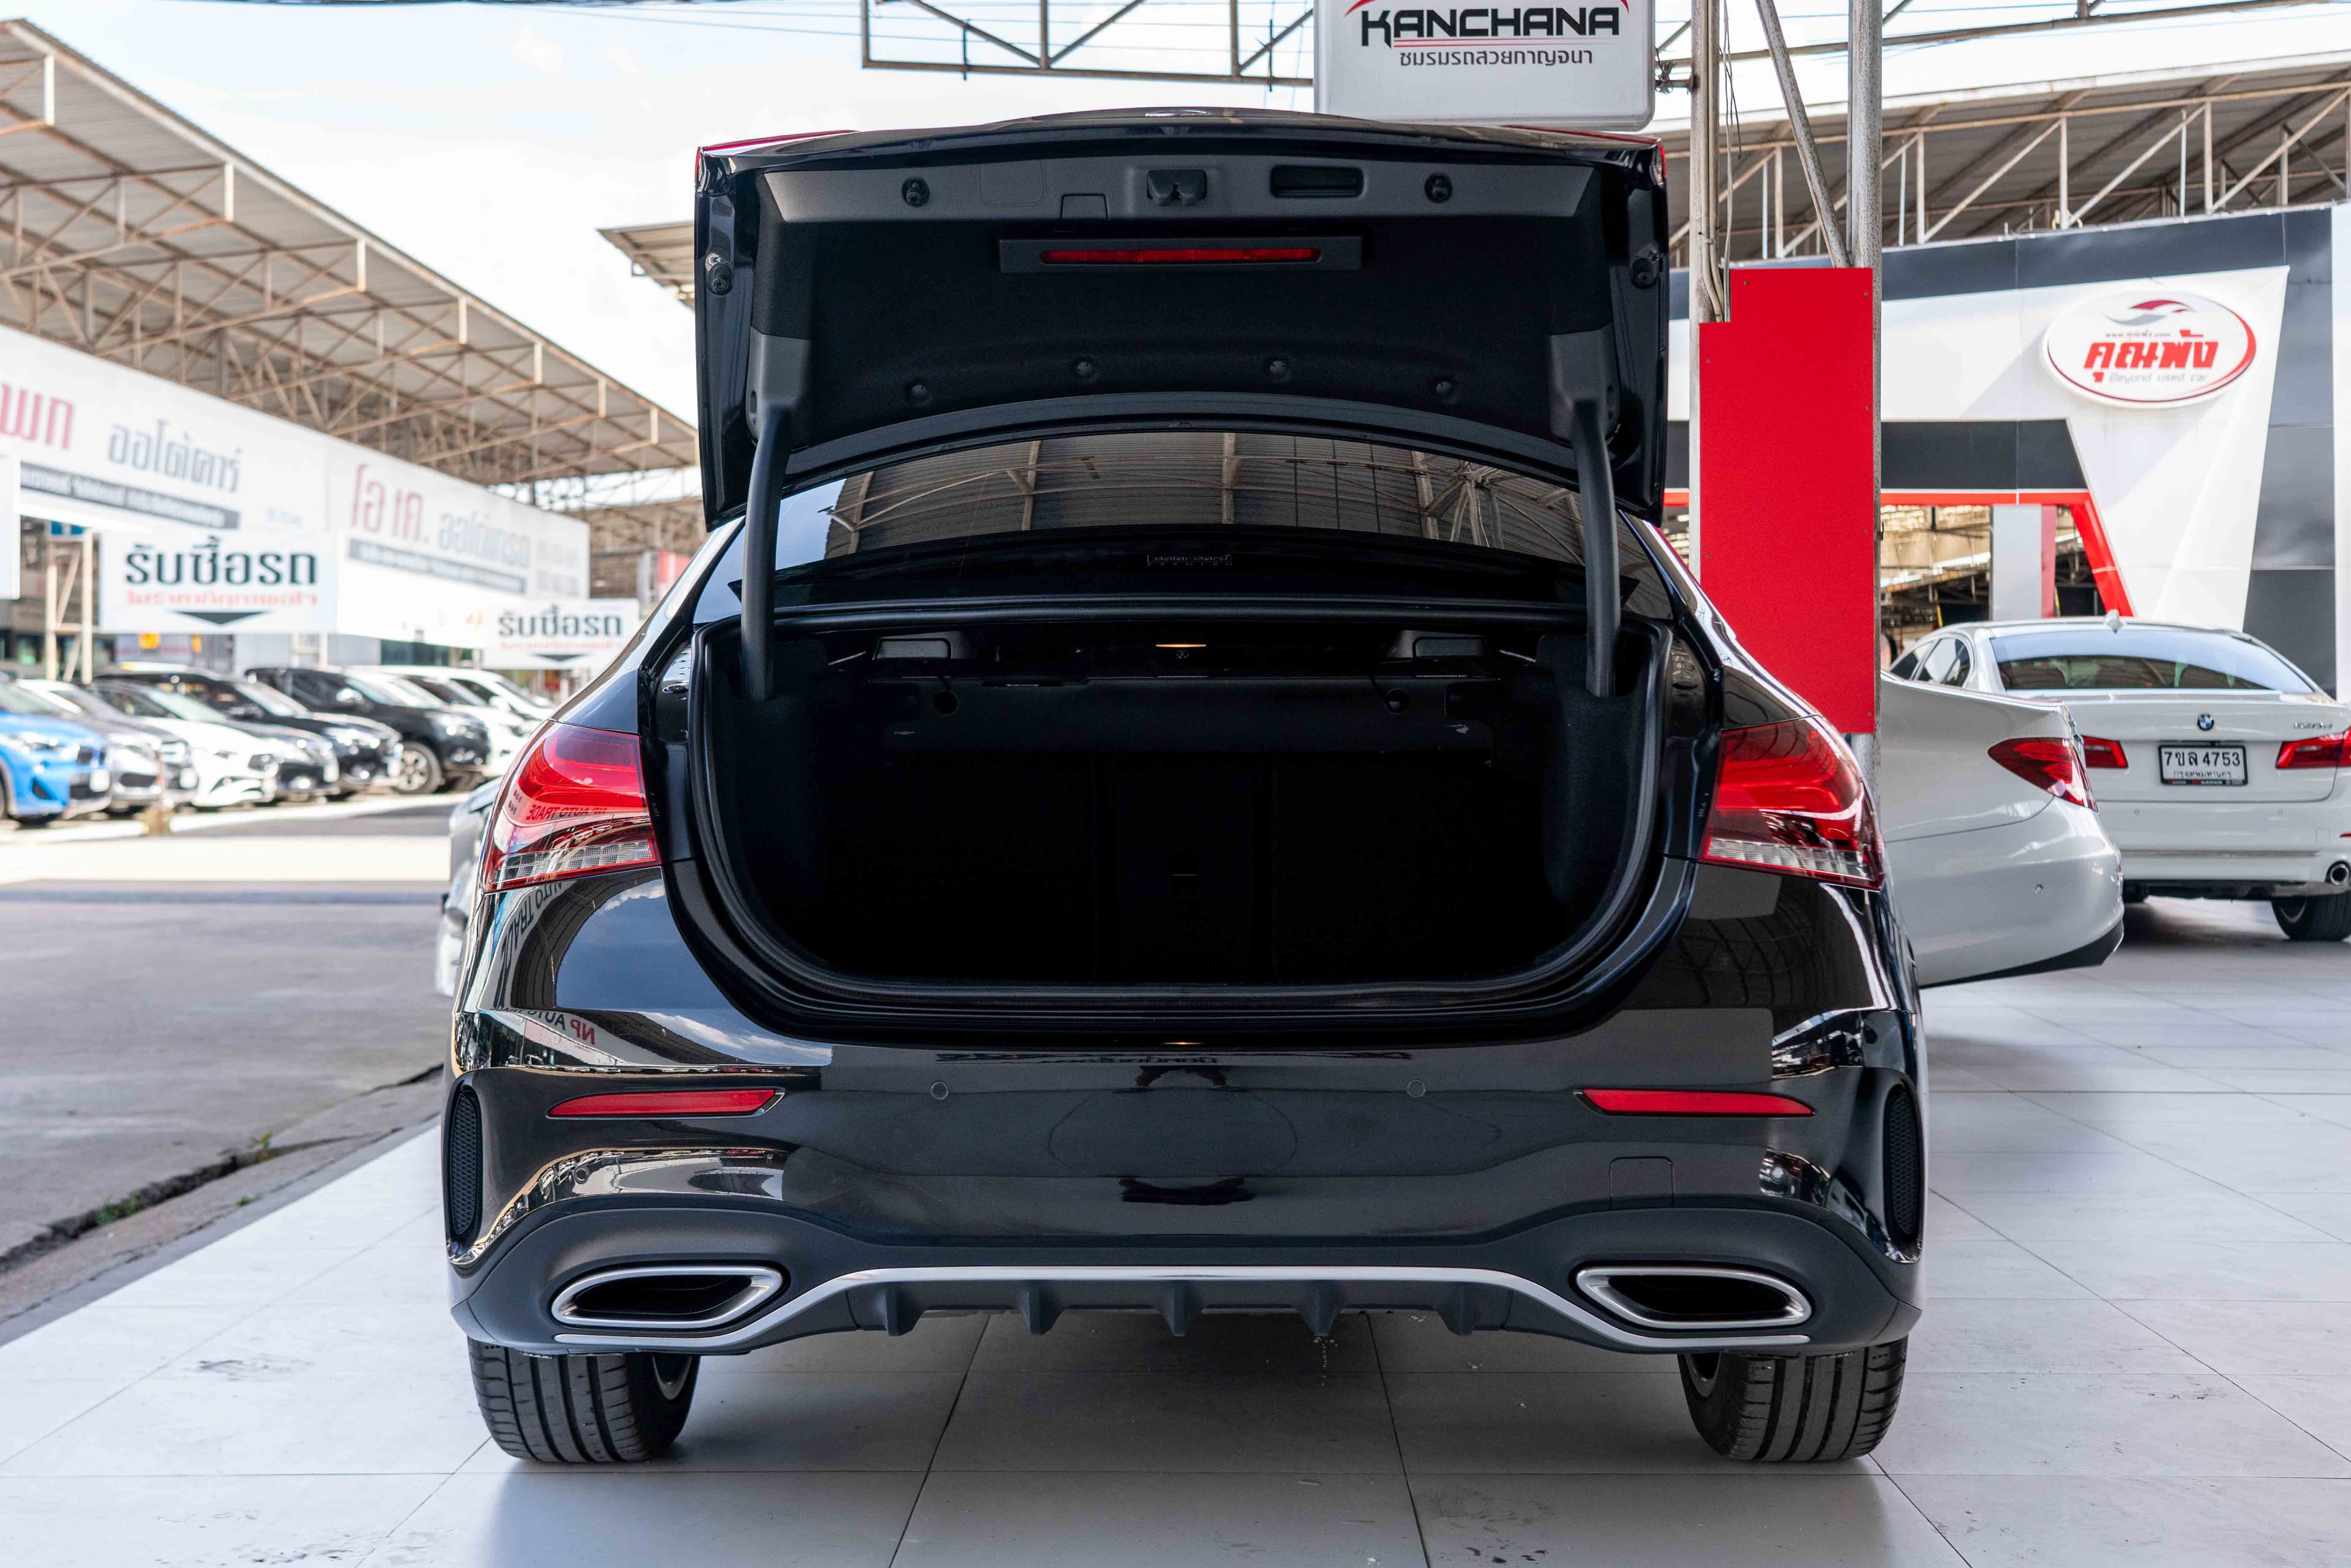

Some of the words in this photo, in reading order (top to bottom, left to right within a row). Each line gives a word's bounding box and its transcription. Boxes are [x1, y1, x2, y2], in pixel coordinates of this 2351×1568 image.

[1361, 7, 1619, 48] KANCHANA
[1400, 50, 1593, 66] ชมรมรถสวยกาญจนา
[2109, 373, 2151, 384] Beyond
[2157, 373, 2186, 382] used
[2190, 373, 2208, 382] car
[125, 535, 317, 585] รับซื้อรถ
[2202, 751, 2241, 767] 4753
